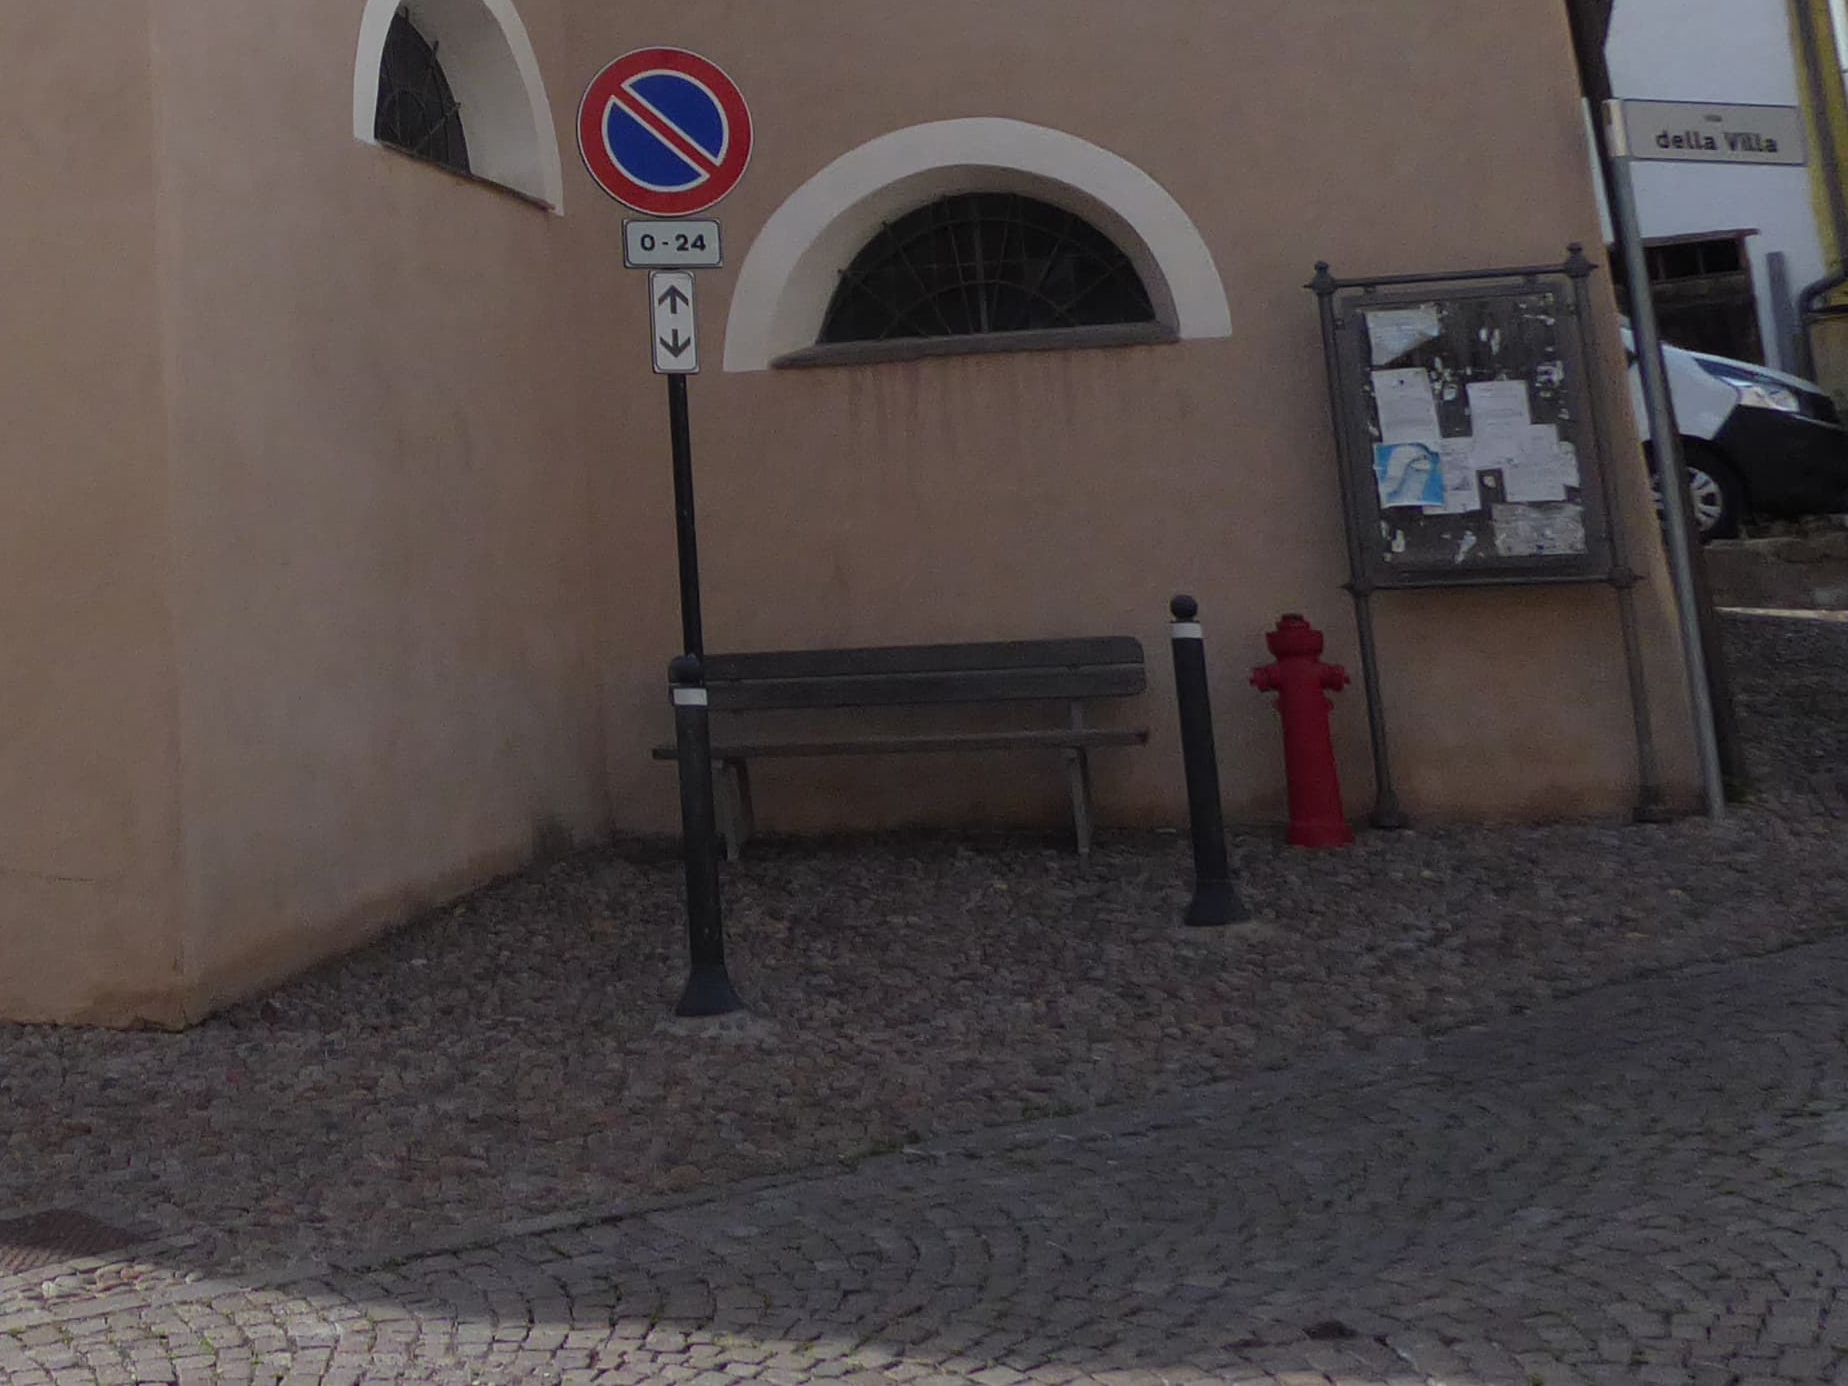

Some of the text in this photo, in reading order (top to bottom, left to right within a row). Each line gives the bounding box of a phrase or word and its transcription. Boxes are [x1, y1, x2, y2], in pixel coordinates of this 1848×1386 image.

[1656, 130, 1778, 152] della Villa
[675, 234, 707, 252] 24
